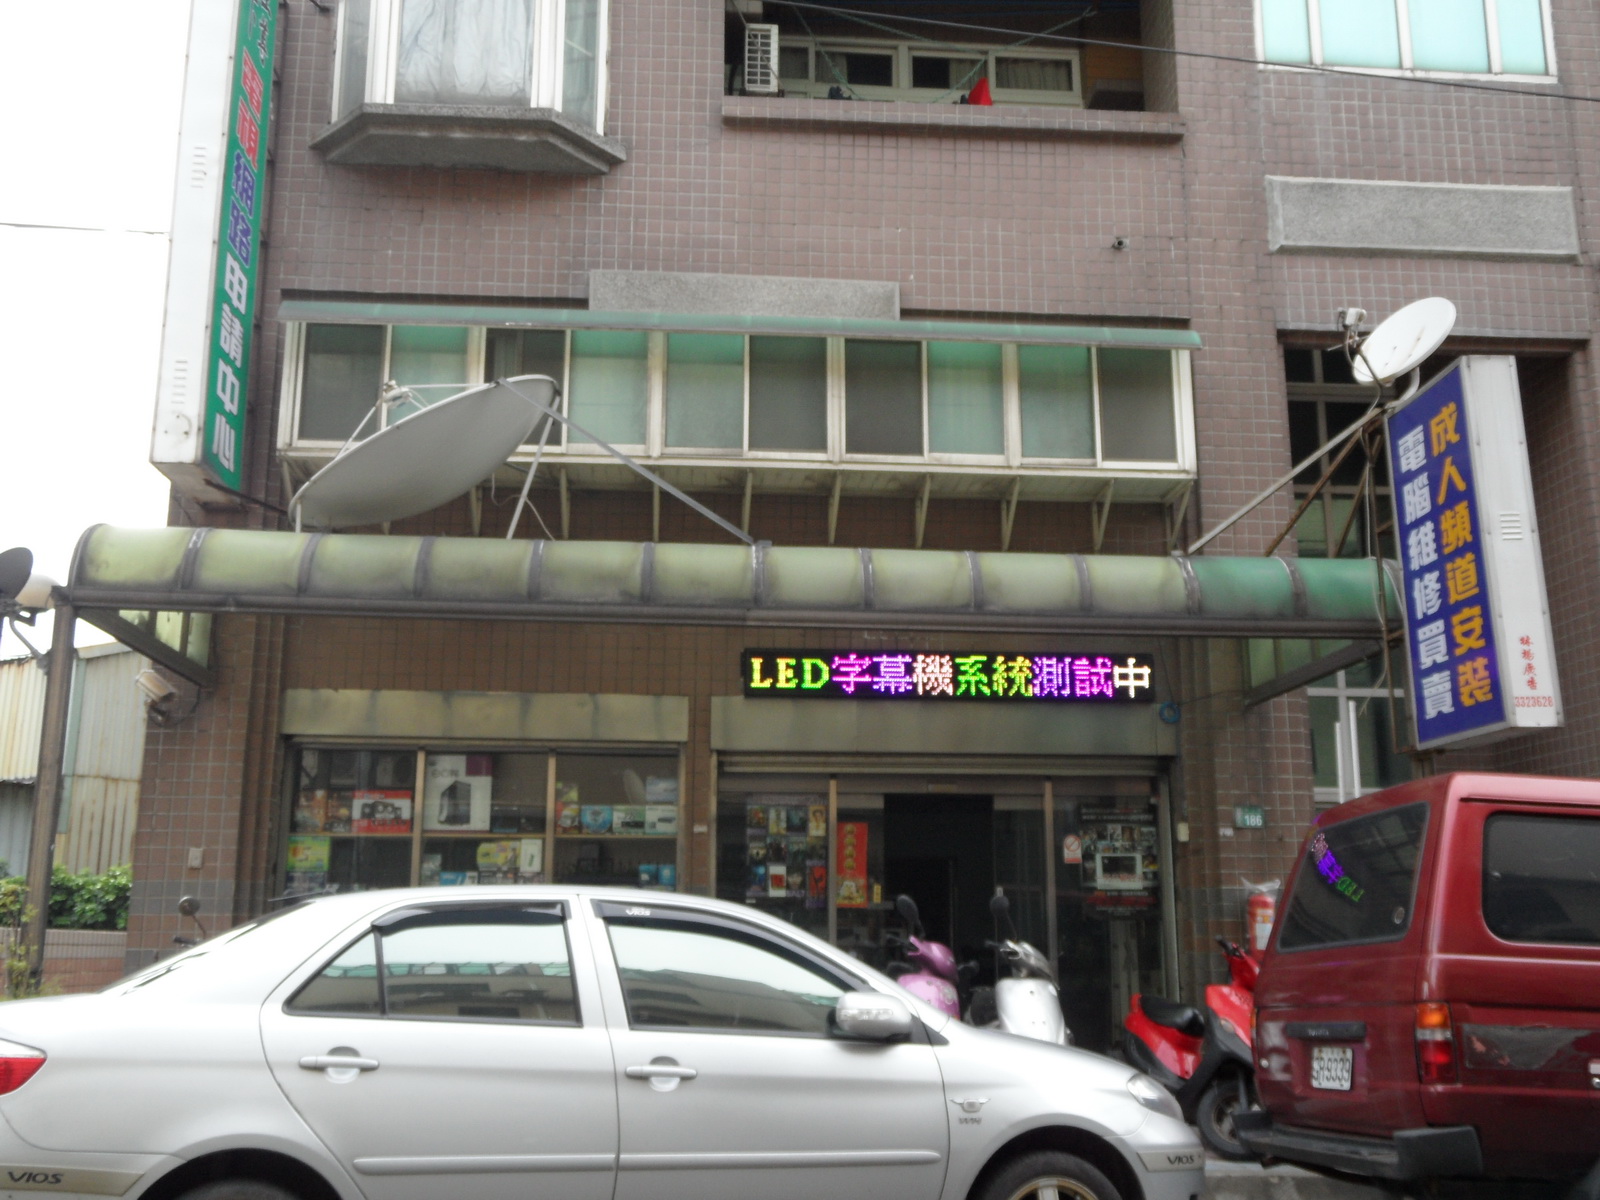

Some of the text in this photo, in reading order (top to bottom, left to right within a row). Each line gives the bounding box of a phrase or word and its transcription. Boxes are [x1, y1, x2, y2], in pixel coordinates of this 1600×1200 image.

[1429, 401, 1493, 707] 成人頻道安裝
[1397, 424, 1455, 720] 電腦維修買賣
[749, 653, 1152, 699] LED字幕機系統測試中
[1514, 695, 1554, 708] 3323628
[1244, 814, 1263, 827] 186
[1166, 1154, 1195, 1166] VIOS
[7, 1171, 64, 1184] VIOS
